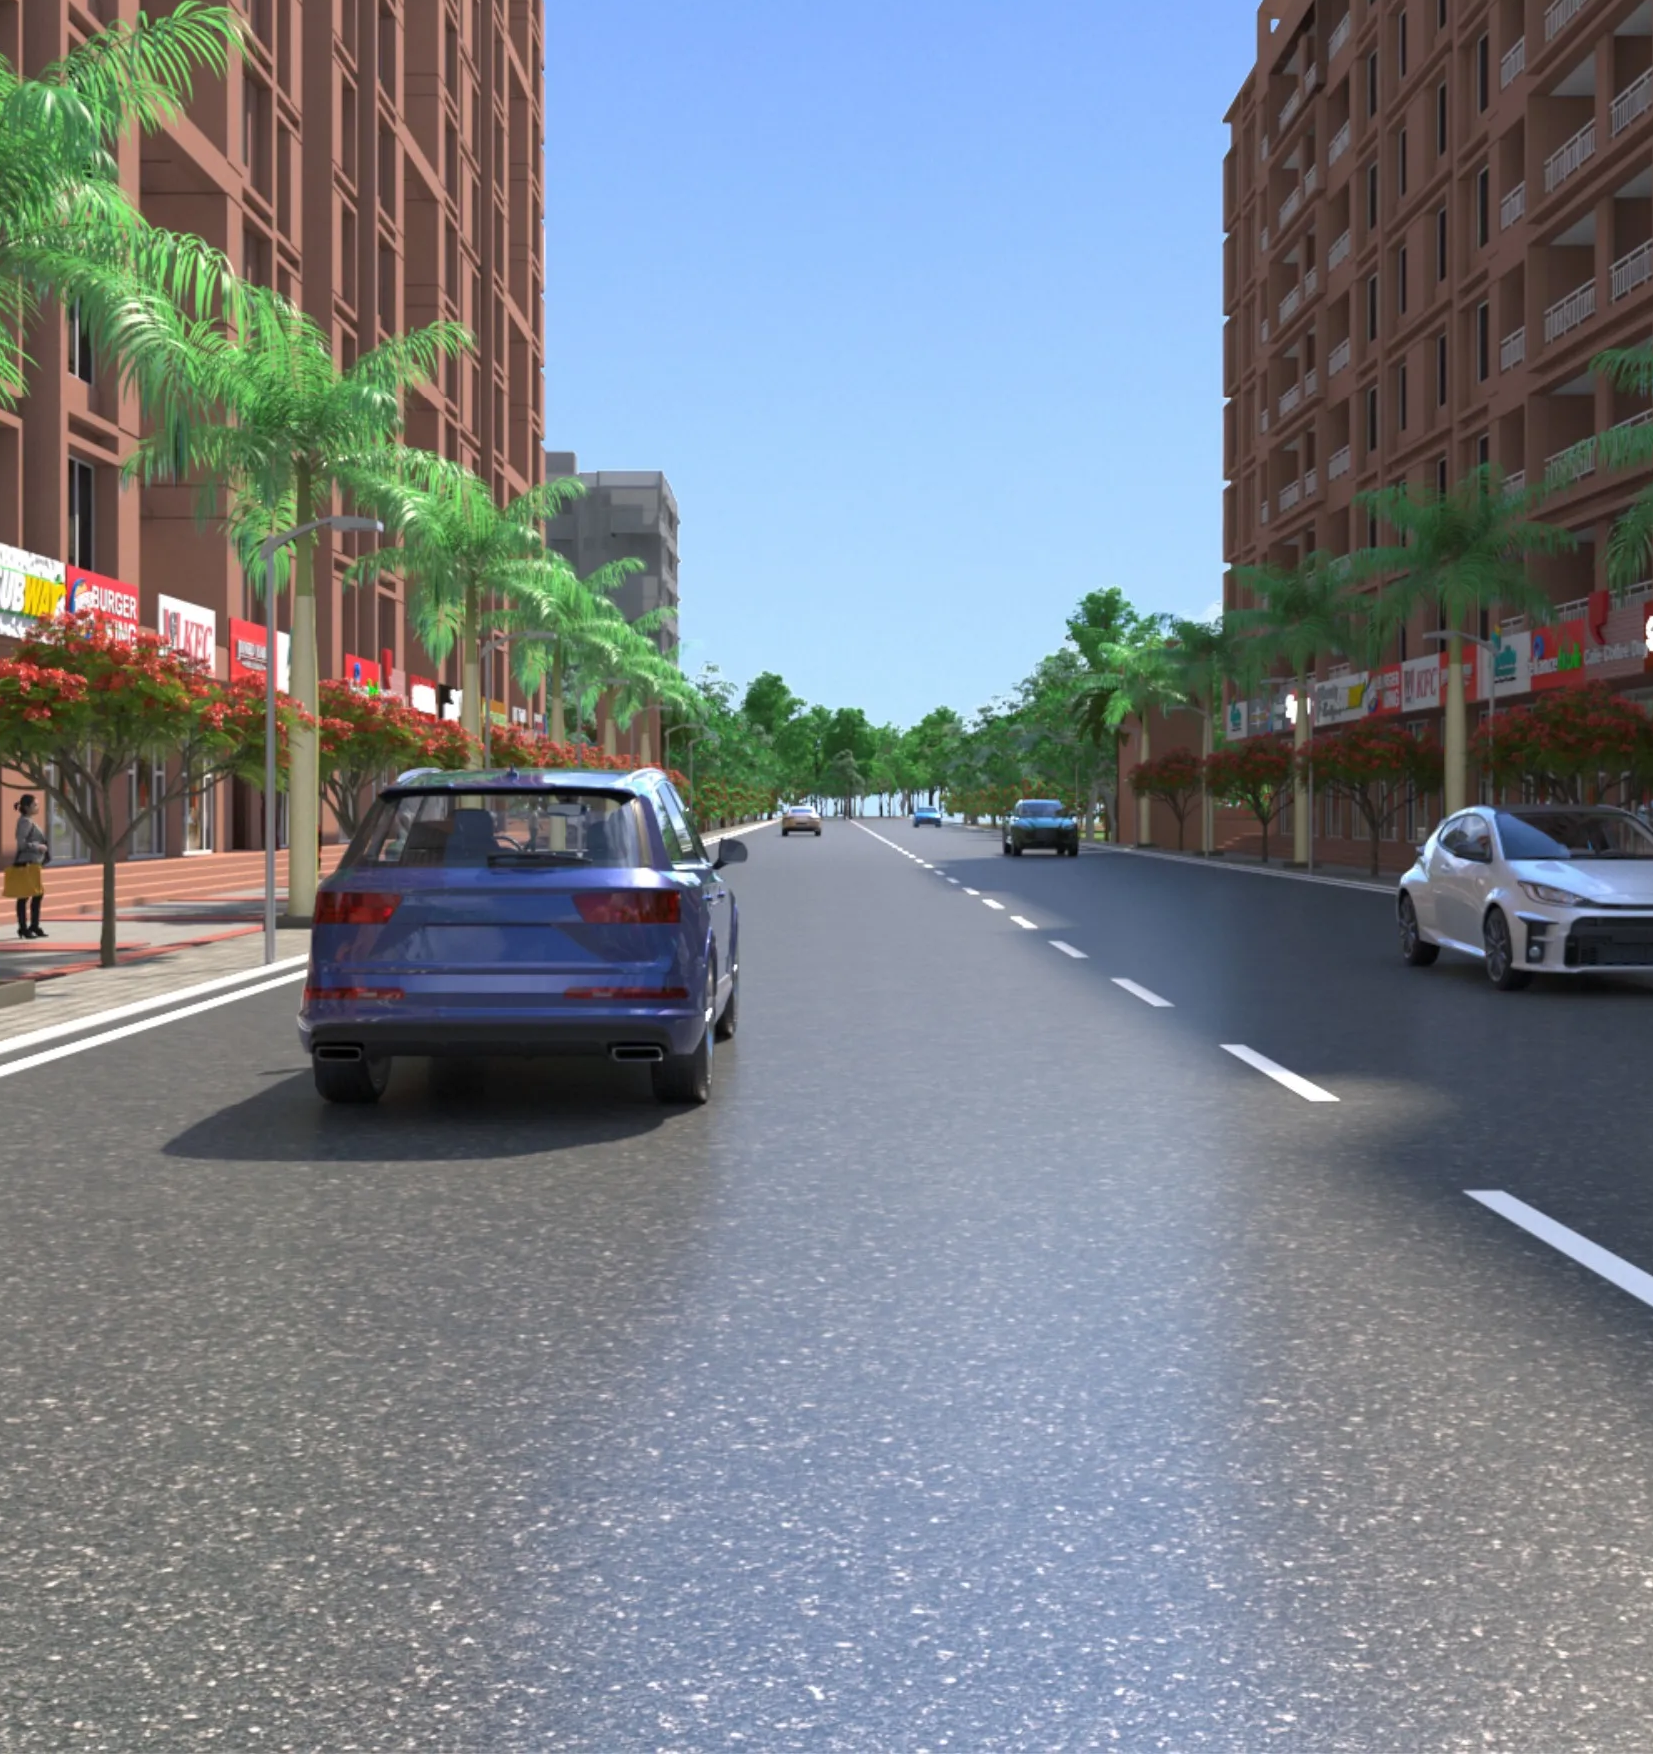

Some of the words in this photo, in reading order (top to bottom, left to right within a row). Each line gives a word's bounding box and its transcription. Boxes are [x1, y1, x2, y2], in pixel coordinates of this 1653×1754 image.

[91, 585, 137, 620] BURGER
[184, 619, 213, 661] KFC
[1416, 666, 1438, 699] KFC
